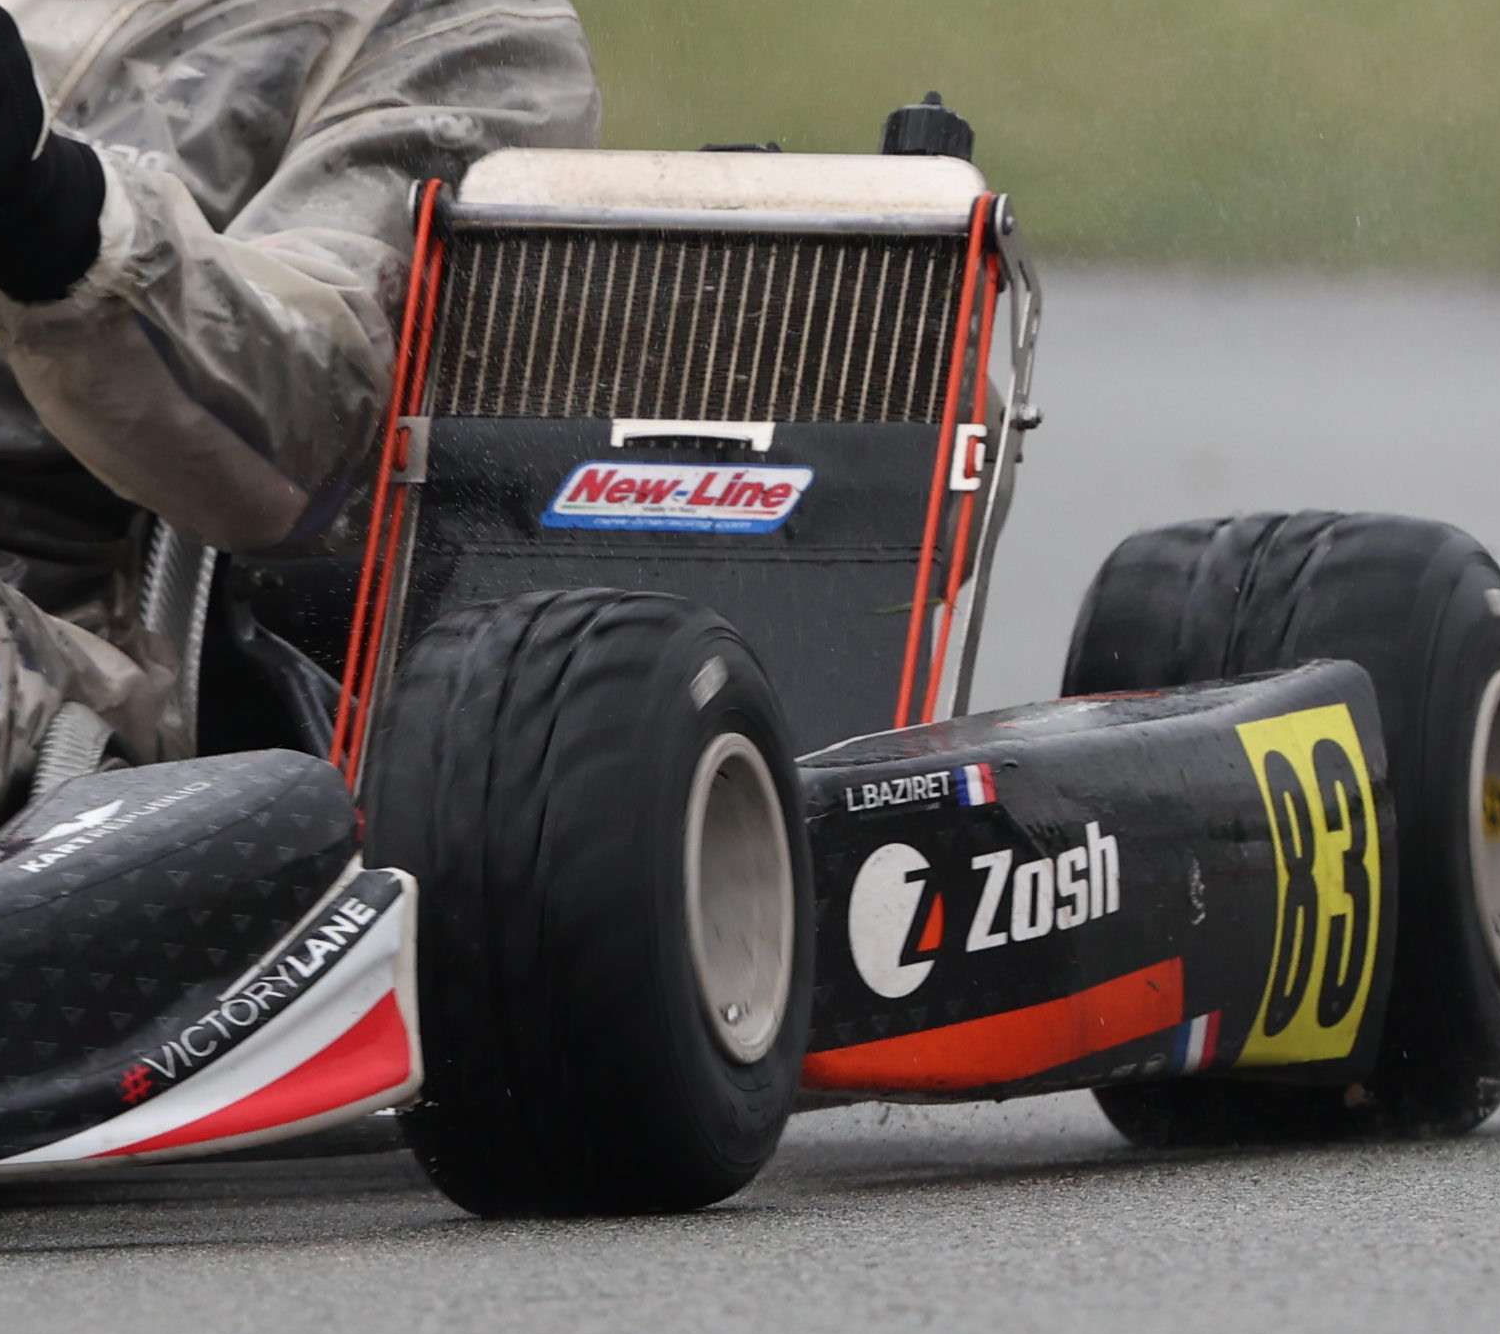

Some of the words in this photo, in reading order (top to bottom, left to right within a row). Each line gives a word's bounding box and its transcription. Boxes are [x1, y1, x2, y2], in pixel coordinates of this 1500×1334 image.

[566, 468, 794, 510] New-Line
[965, 820, 1120, 953] Zosh
[1263, 738, 1371, 1037] 83
[120, 897, 377, 1105] #VICTORYLANE
